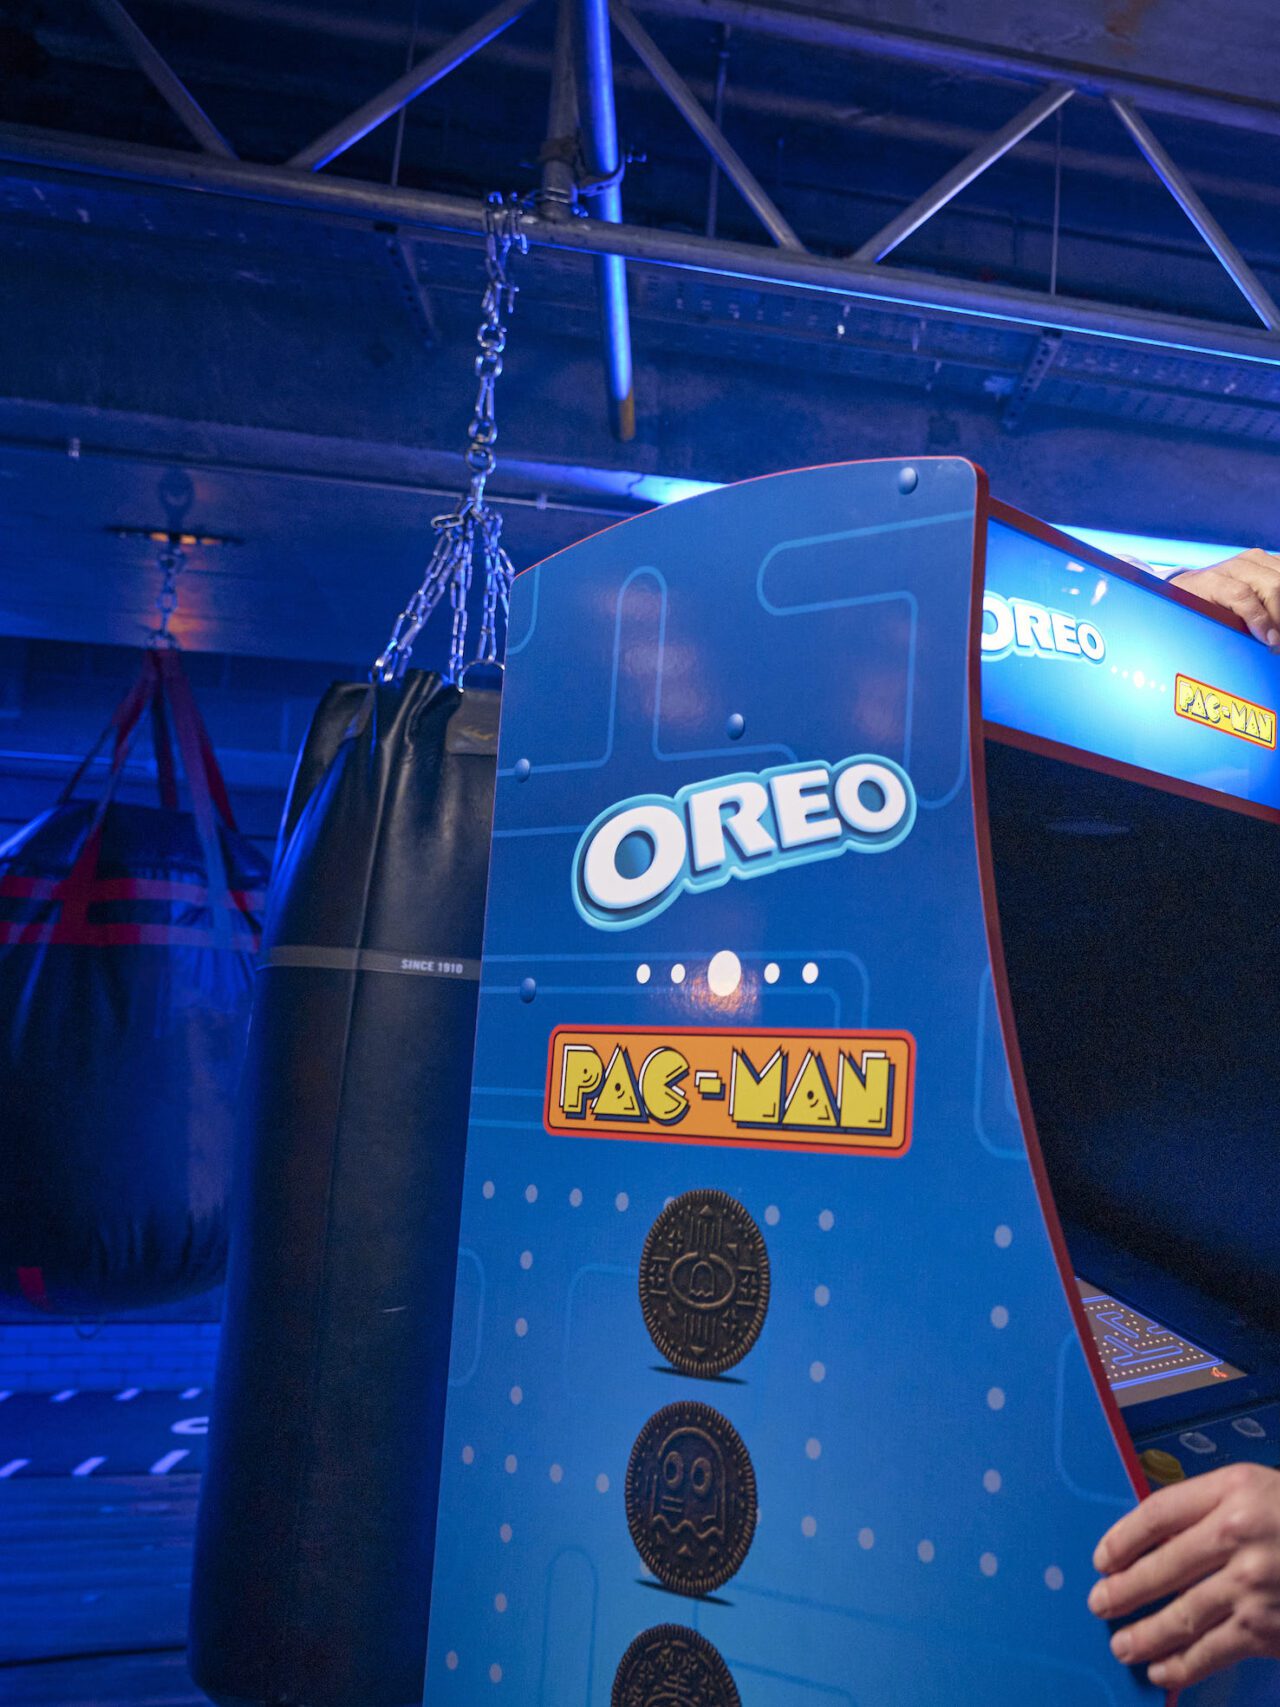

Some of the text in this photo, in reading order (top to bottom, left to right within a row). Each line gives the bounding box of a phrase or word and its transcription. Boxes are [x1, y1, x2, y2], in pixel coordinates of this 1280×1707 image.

[981, 594, 1274, 745] OREO PAC-MAN
[580, 760, 909, 914] OREO
[401, 959, 464, 974] SINCE 1910
[558, 1041, 898, 1138] PAC-MAN
